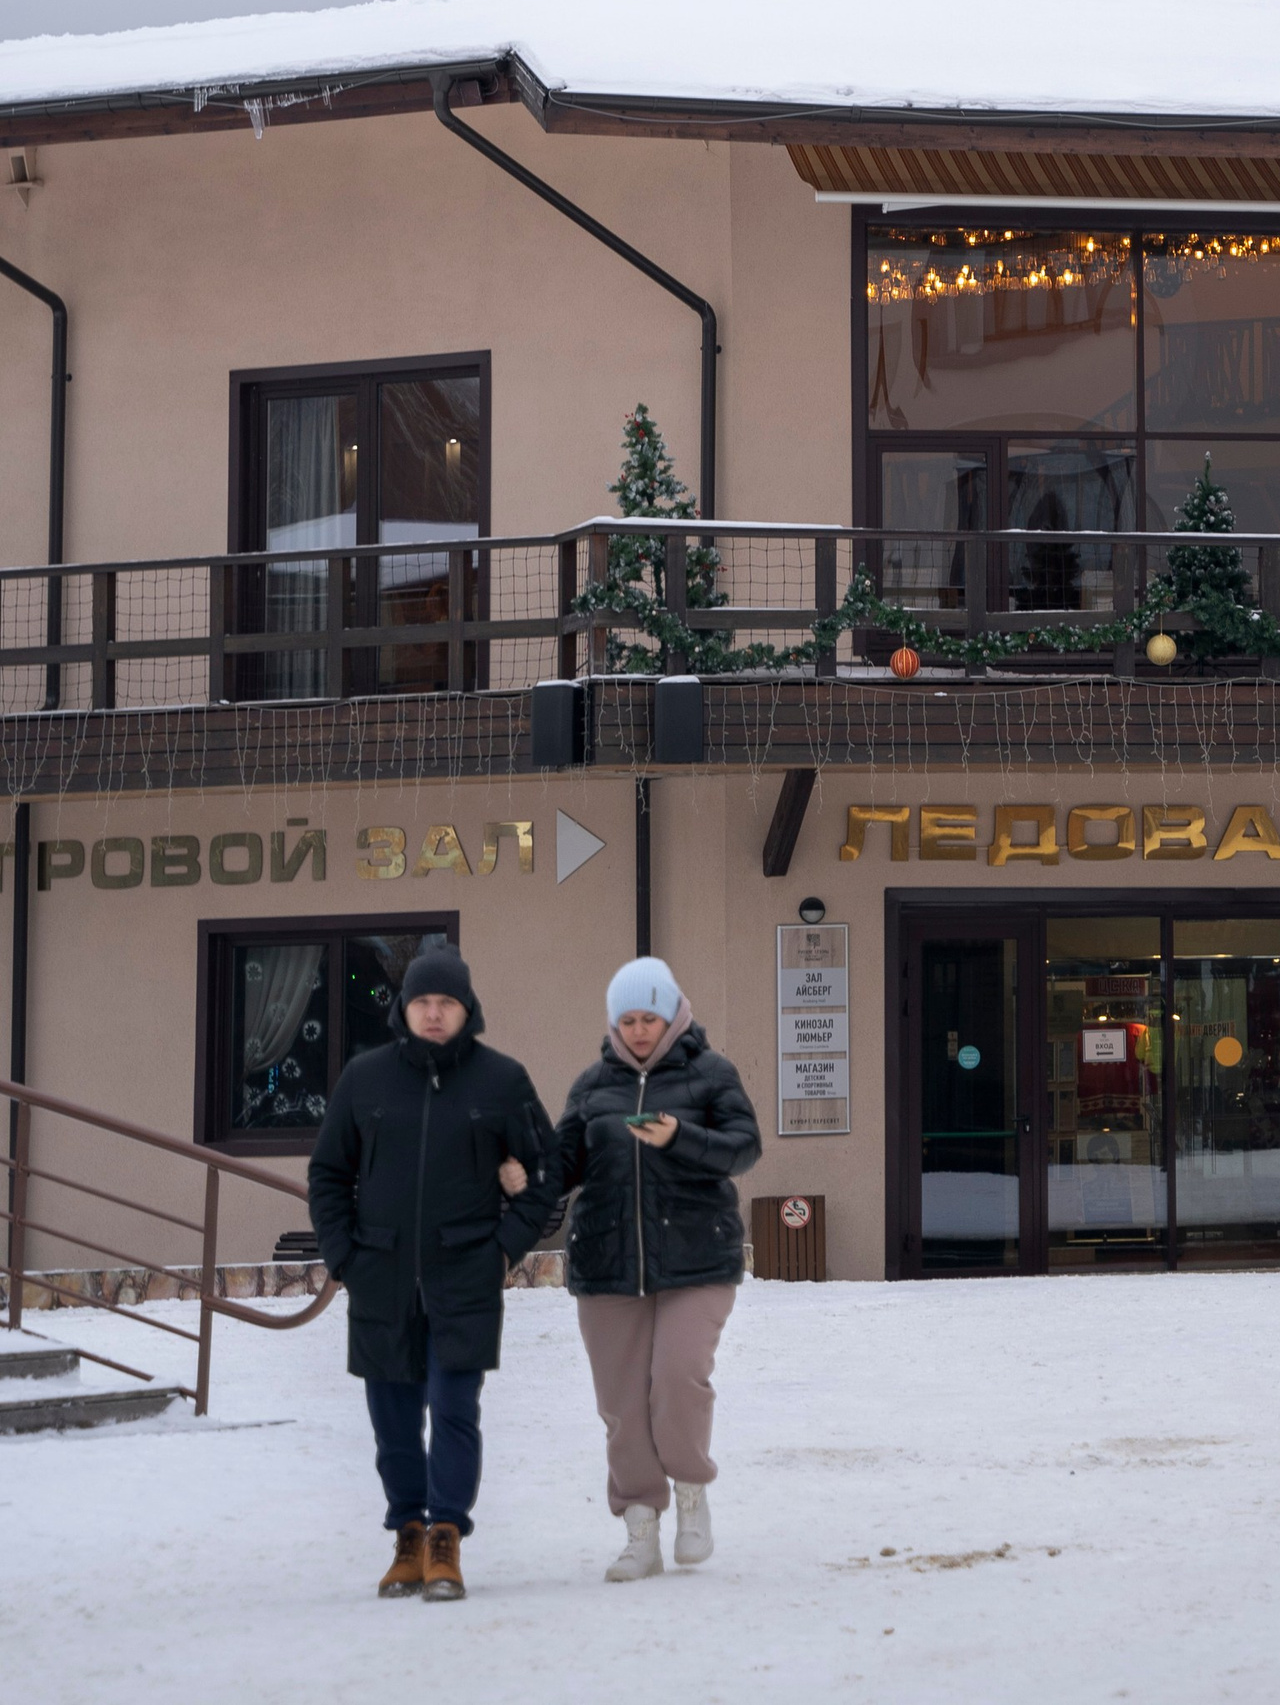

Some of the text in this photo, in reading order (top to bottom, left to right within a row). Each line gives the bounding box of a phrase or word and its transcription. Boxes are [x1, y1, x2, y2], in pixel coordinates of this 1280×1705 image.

[355, 821, 535, 881] ЗАЛ
[805, 973, 822, 983] ЗАЛ
[796, 985, 832, 996] АЙСБЕРГ
[794, 1019, 834, 1029] КИНОЗАЛ
[796, 1032, 832, 1043] ЛЮМЬЕР
[1095, 1042, 1114, 1050] ВХОД
[795, 1063, 834, 1073] МАГАЗИН
